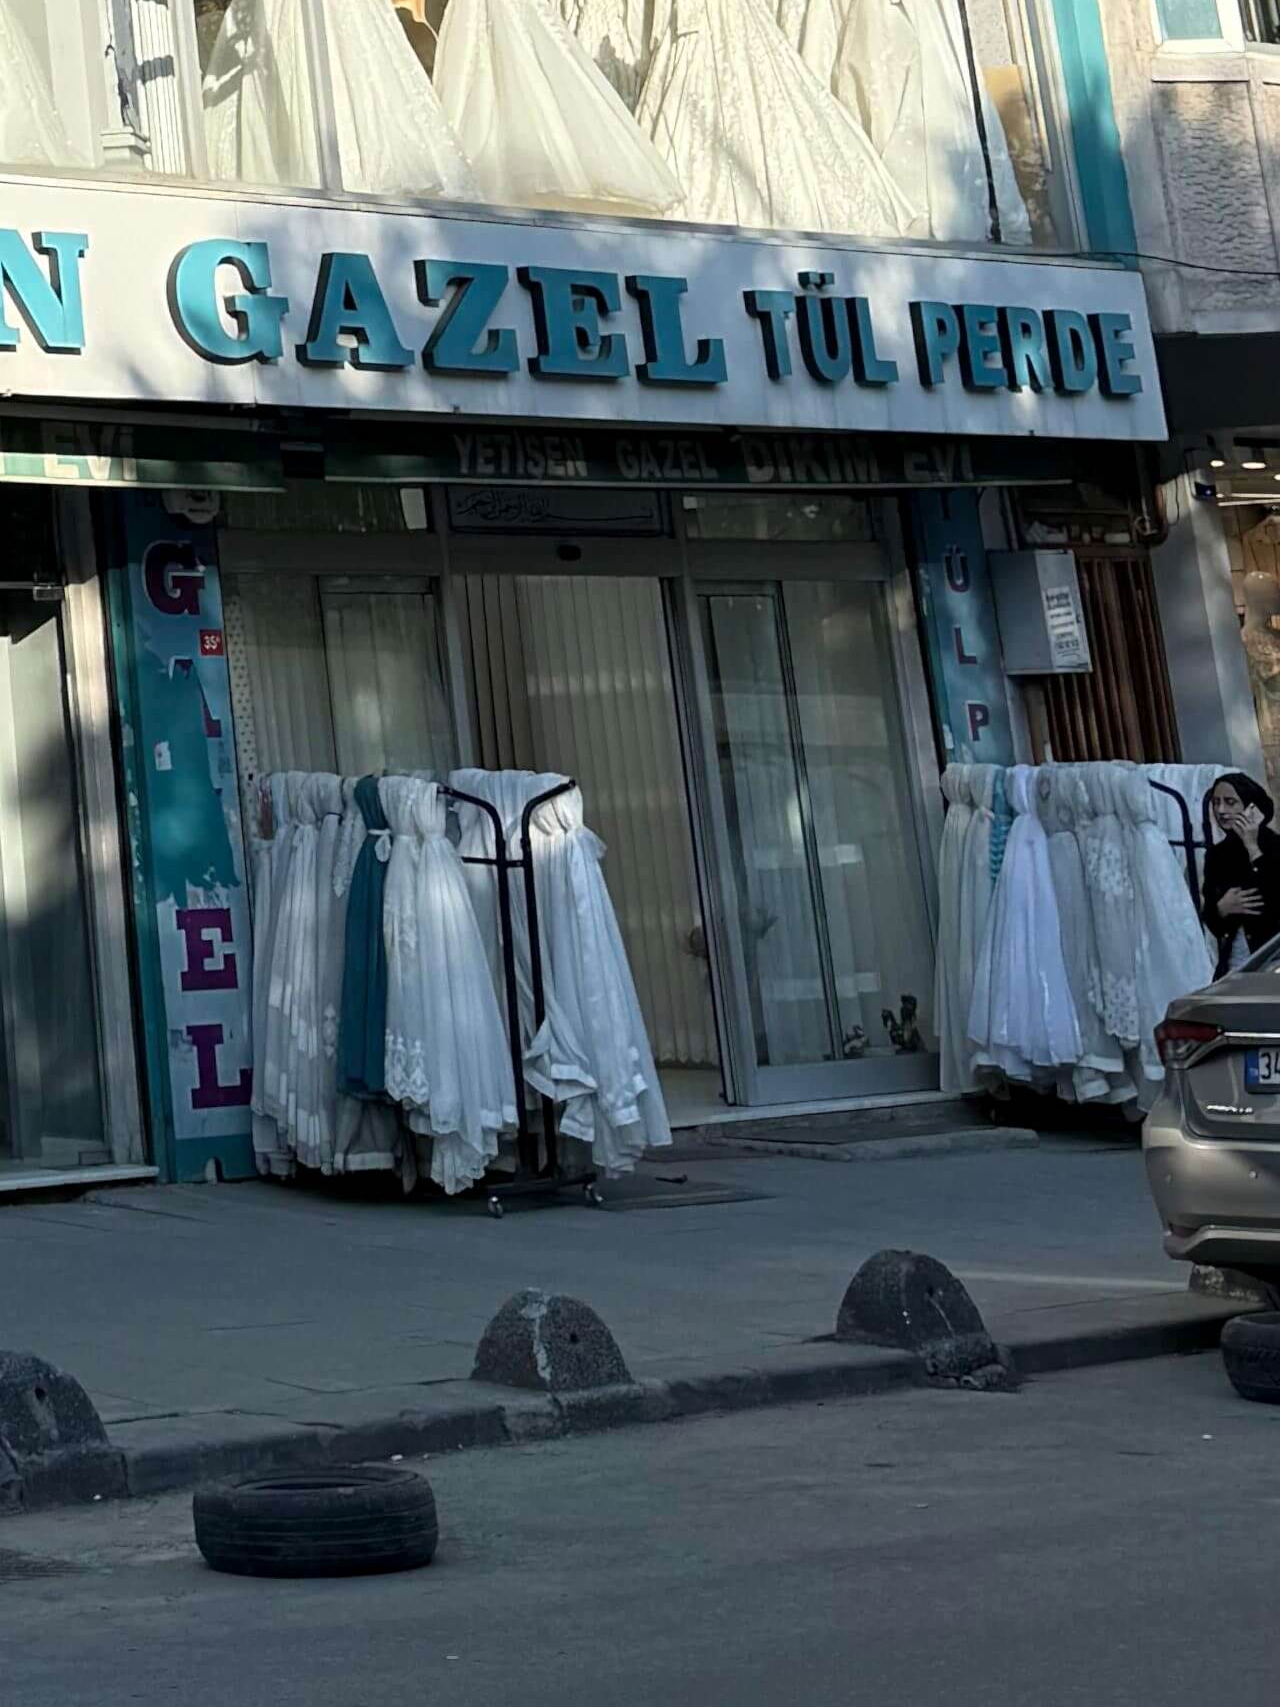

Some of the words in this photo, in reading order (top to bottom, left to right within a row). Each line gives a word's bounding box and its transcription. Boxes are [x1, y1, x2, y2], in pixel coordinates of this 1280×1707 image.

[168, 237, 727, 387] GAZEL
[744, 270, 897, 387] TÜL
[910, 299, 1144, 397] PERDE
[145, 540, 253, 1110] GEL
